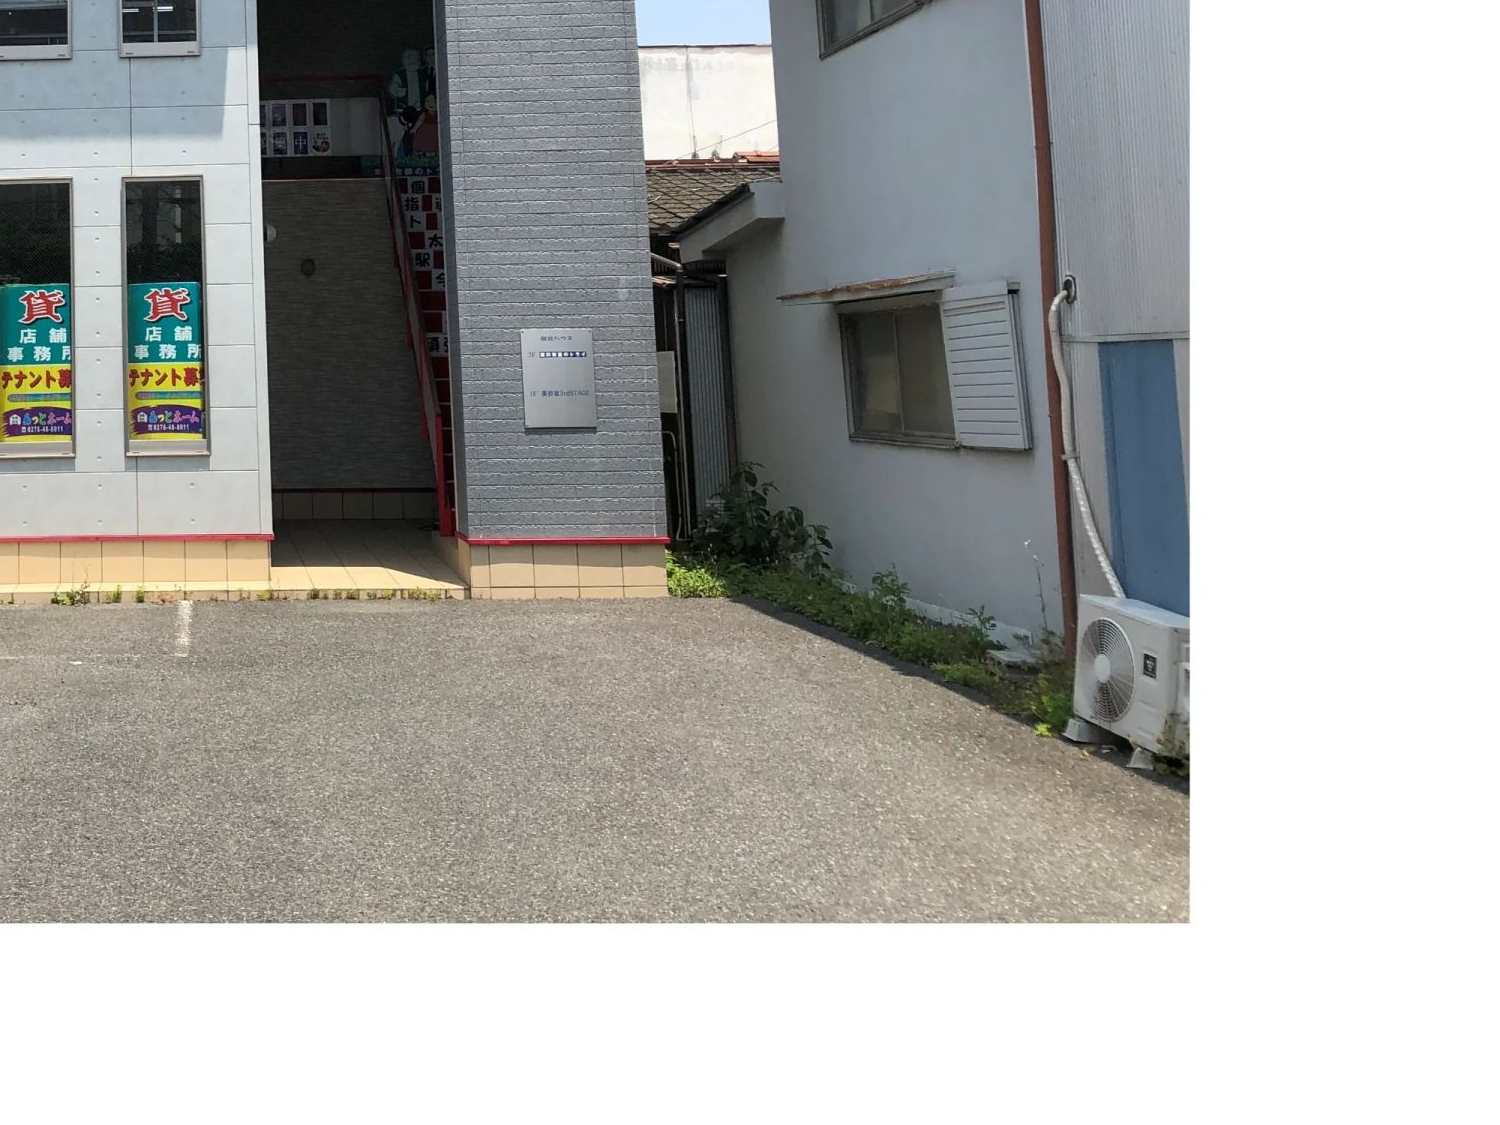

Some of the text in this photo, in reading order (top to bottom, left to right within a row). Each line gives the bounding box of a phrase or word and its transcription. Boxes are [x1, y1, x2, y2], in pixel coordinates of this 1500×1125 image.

[18, 289, 66, 324] 貸
[143, 287, 191, 322] 貸
[19, 328, 67, 344] 店舗
[145, 326, 193, 342] 店舗
